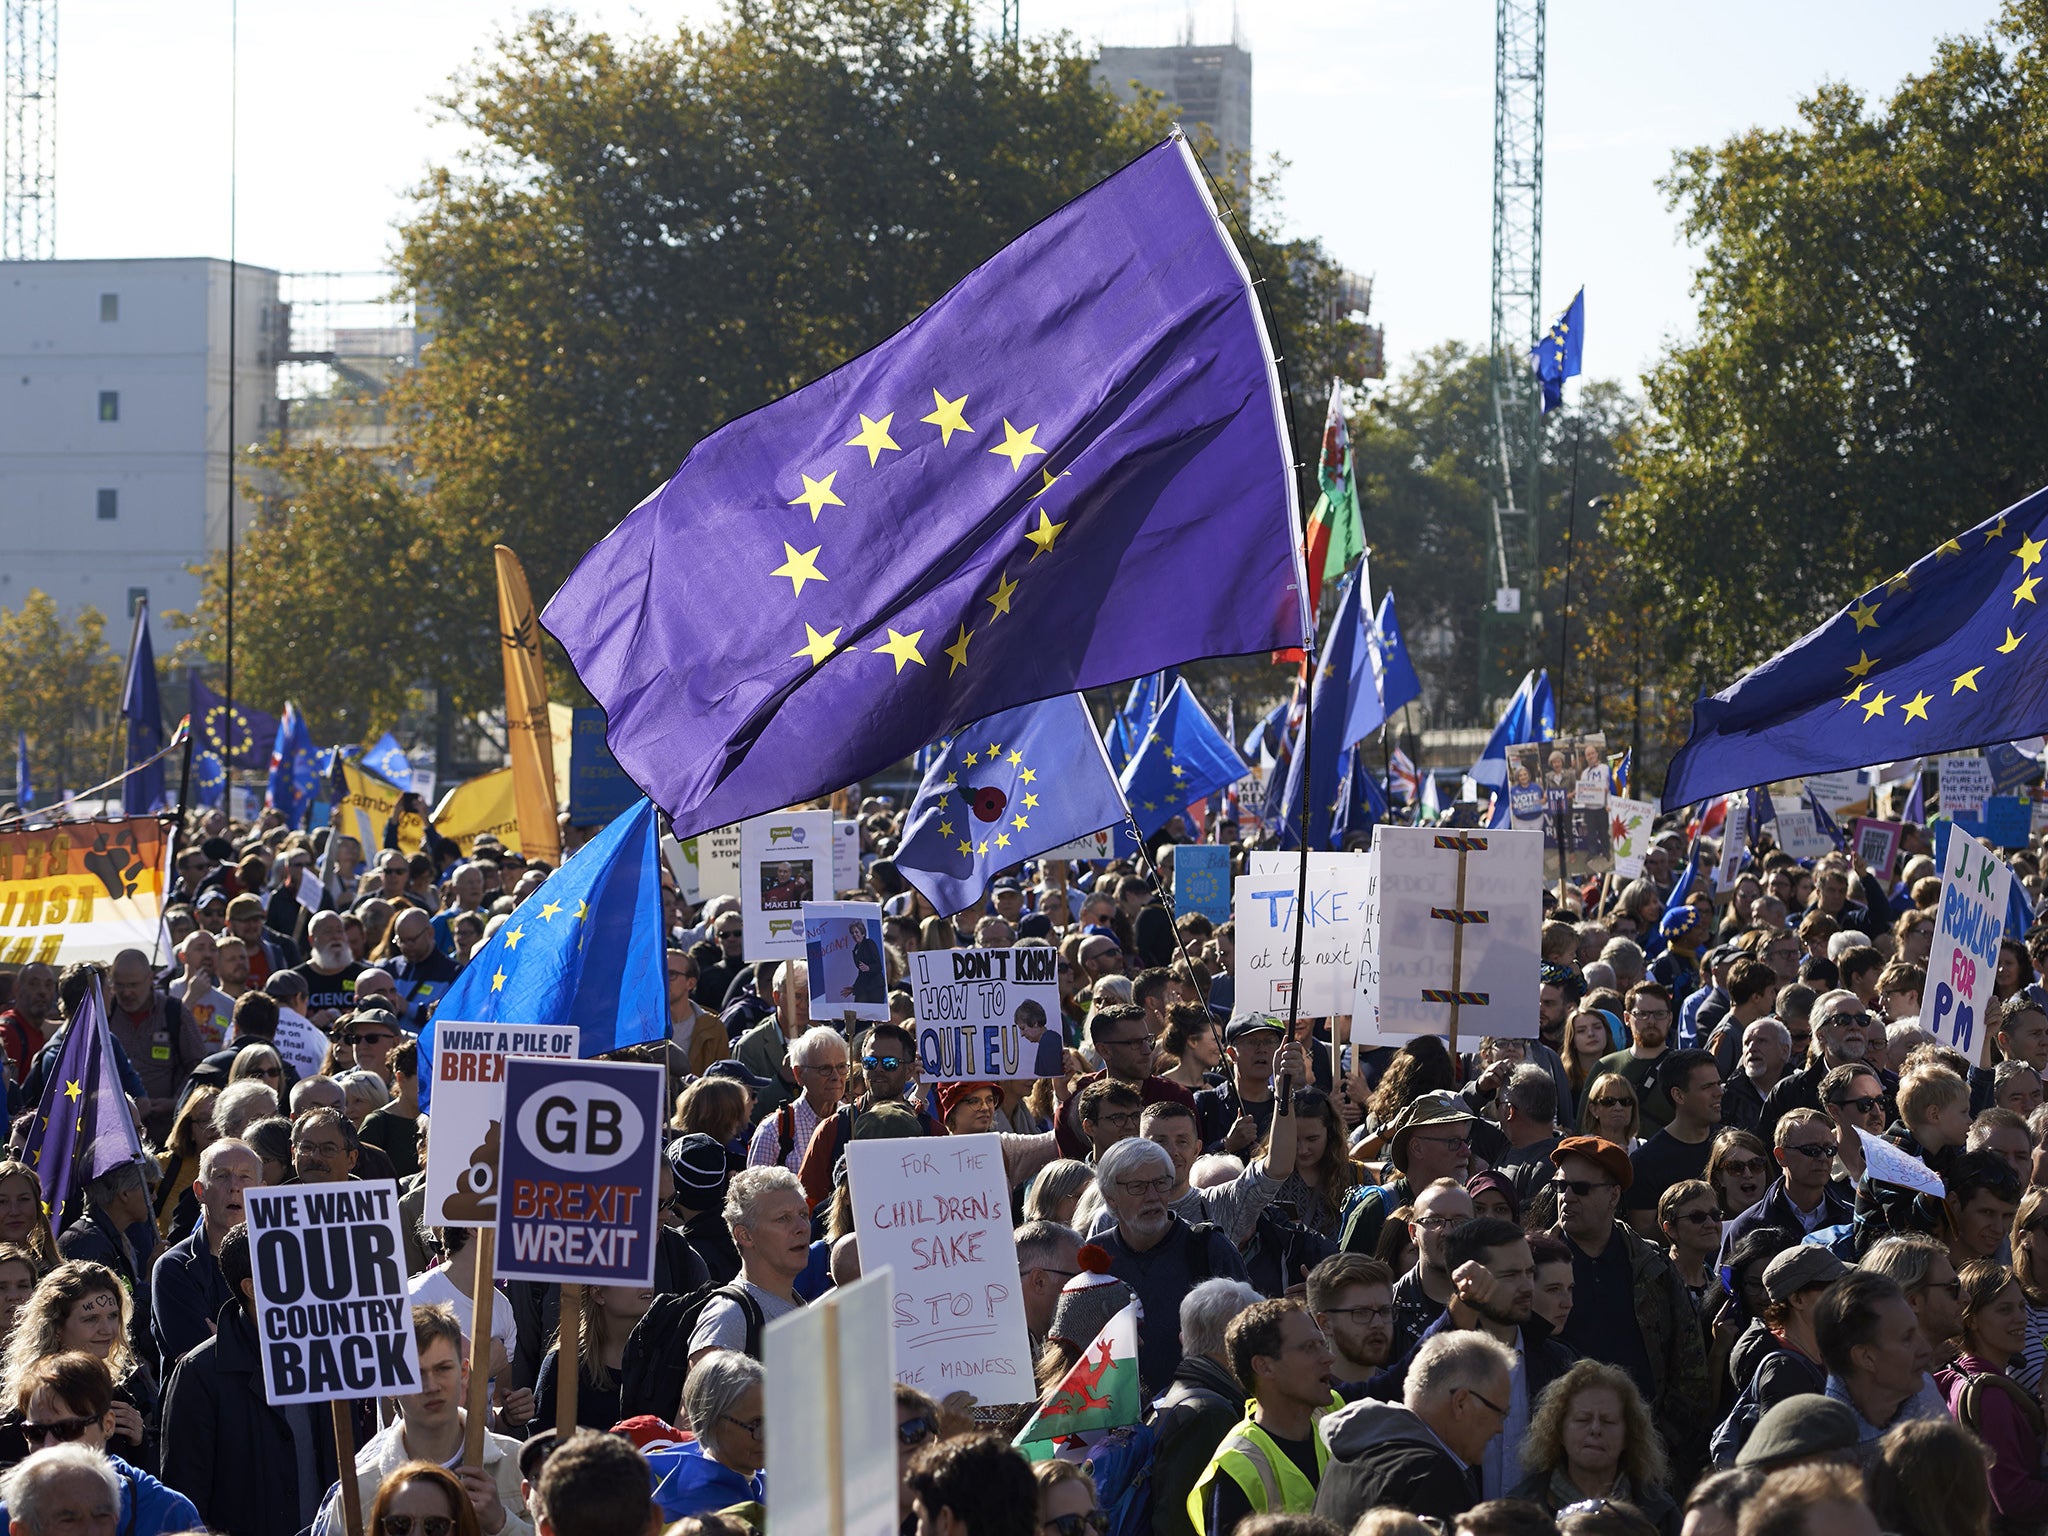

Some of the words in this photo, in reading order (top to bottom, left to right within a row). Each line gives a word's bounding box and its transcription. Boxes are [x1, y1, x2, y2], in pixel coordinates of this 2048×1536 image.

[1240, 782, 1260, 791] XIT
[764, 901, 788, 909] MAKE
[1251, 889, 1349, 933] TAKE
[1941, 882, 2001, 969] ROWLING
[918, 954, 930, 985] I
[951, 950, 1010, 981] DON'T
[1015, 950, 1057, 981] KNOW
[1250, 948, 1272, 970] at
[1316, 943, 1353, 966] next
[1951, 948, 1976, 1000] FOR
[920, 983, 968, 1020] HOW
[978, 982, 1006, 1020] TO
[442, 1031, 494, 1050] WHAT
[497, 1032, 508, 1051] A
[512, 1033, 547, 1053] PILE
[551, 1034, 573, 1053] OF
[920, 1024, 977, 1077] QUIT
[983, 1024, 1019, 1075] EU
[535, 1095, 623, 1156] GB
[901, 1153, 941, 1178] FOR
[951, 1148, 989, 1173] THE
[249, 1195, 300, 1229] WE
[303, 1189, 391, 1225] WANT
[512, 1179, 642, 1225] BREXIT
[256, 1224, 402, 1305] OUR
[511, 1222, 639, 1267] WREXIT
[911, 1230, 987, 1270] SAKE
[264, 1297, 405, 1341] COUNTRY
[892, 1284, 1010, 1328] STOP
[269, 1332, 416, 1397] BACK
[896, 1367, 926, 1385] THE
[941, 1357, 1017, 1379] MADNESS
